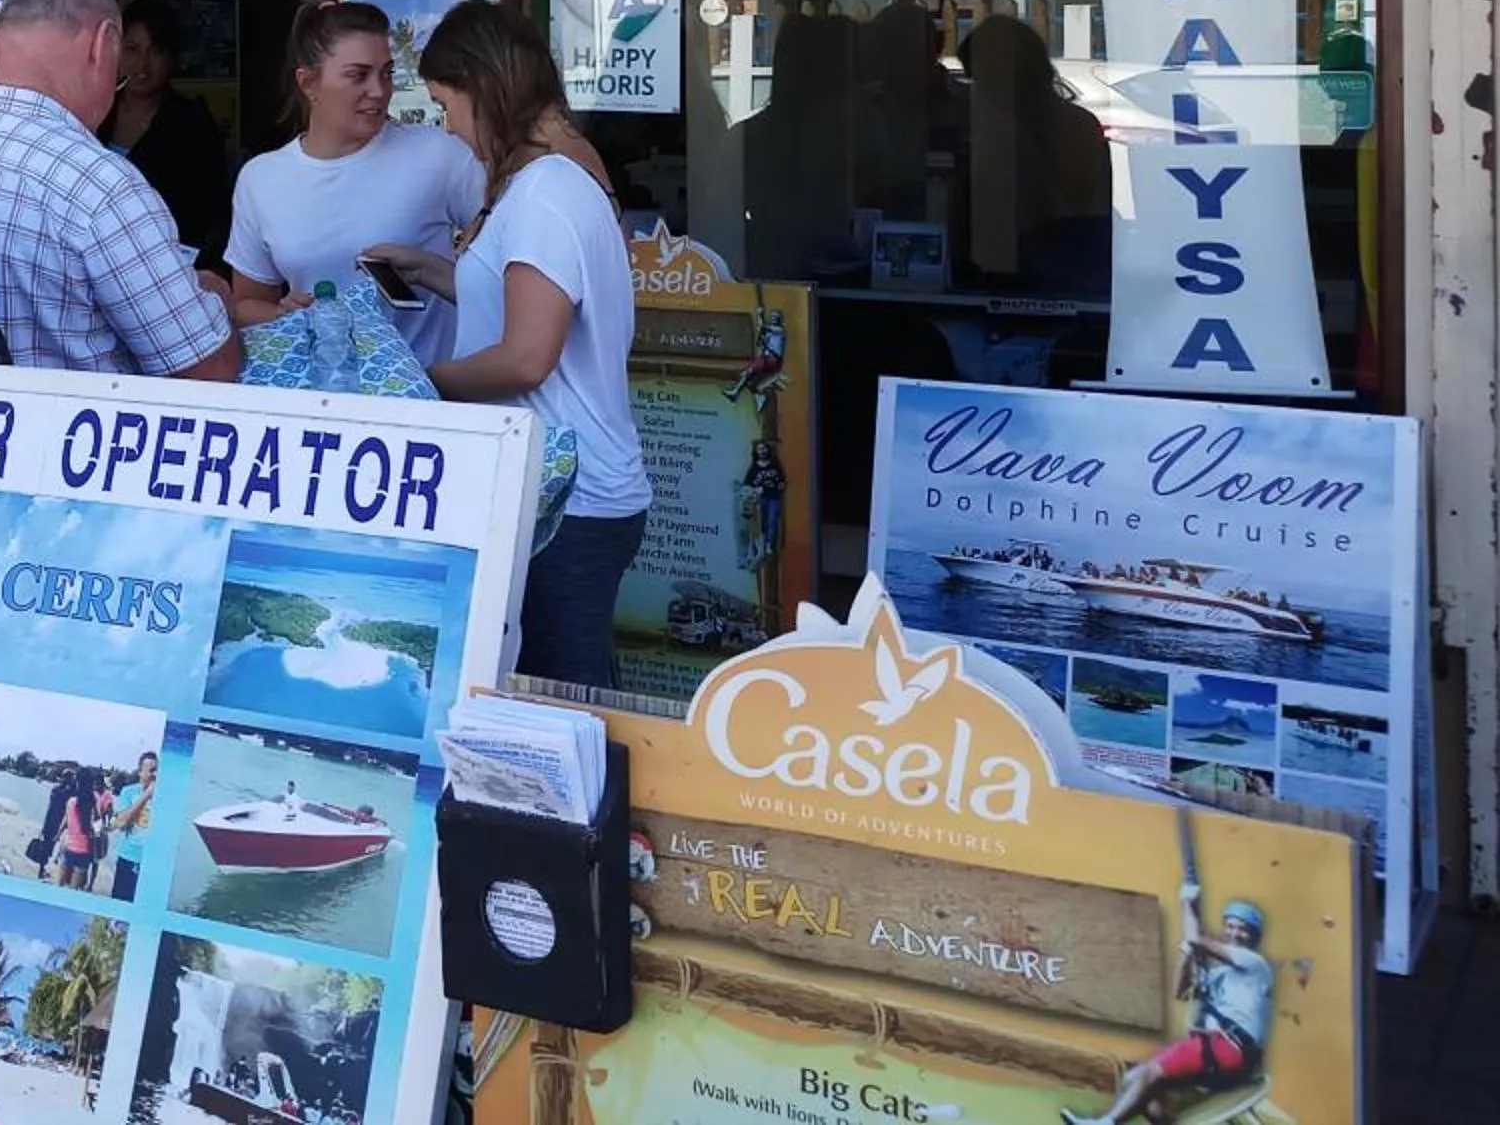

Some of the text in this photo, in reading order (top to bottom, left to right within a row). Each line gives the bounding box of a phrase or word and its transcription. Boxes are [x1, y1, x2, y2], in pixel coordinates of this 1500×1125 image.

[573, 47, 657, 71] HAPPY
[574, 75, 656, 97] MORIS
[59, 406, 448, 533] OPERATOR
[924, 405, 1365, 513] Vava Voom
[926, 486, 1353, 552] Dolphine Cruise
[0, 561, 184, 636] CERFS
[705, 668, 1033, 825] Casela
[728, 842, 769, 871] THE
[739, 792, 1008, 856] WORLD OF ADVENTURES
[707, 869, 853, 940] REAL
[869, 918, 1070, 986] ADVENTURE
[693, 1076, 740, 1104] (Walk
[742, 1094, 782, 1117] with
[799, 1066, 930, 1125] Big Cats
